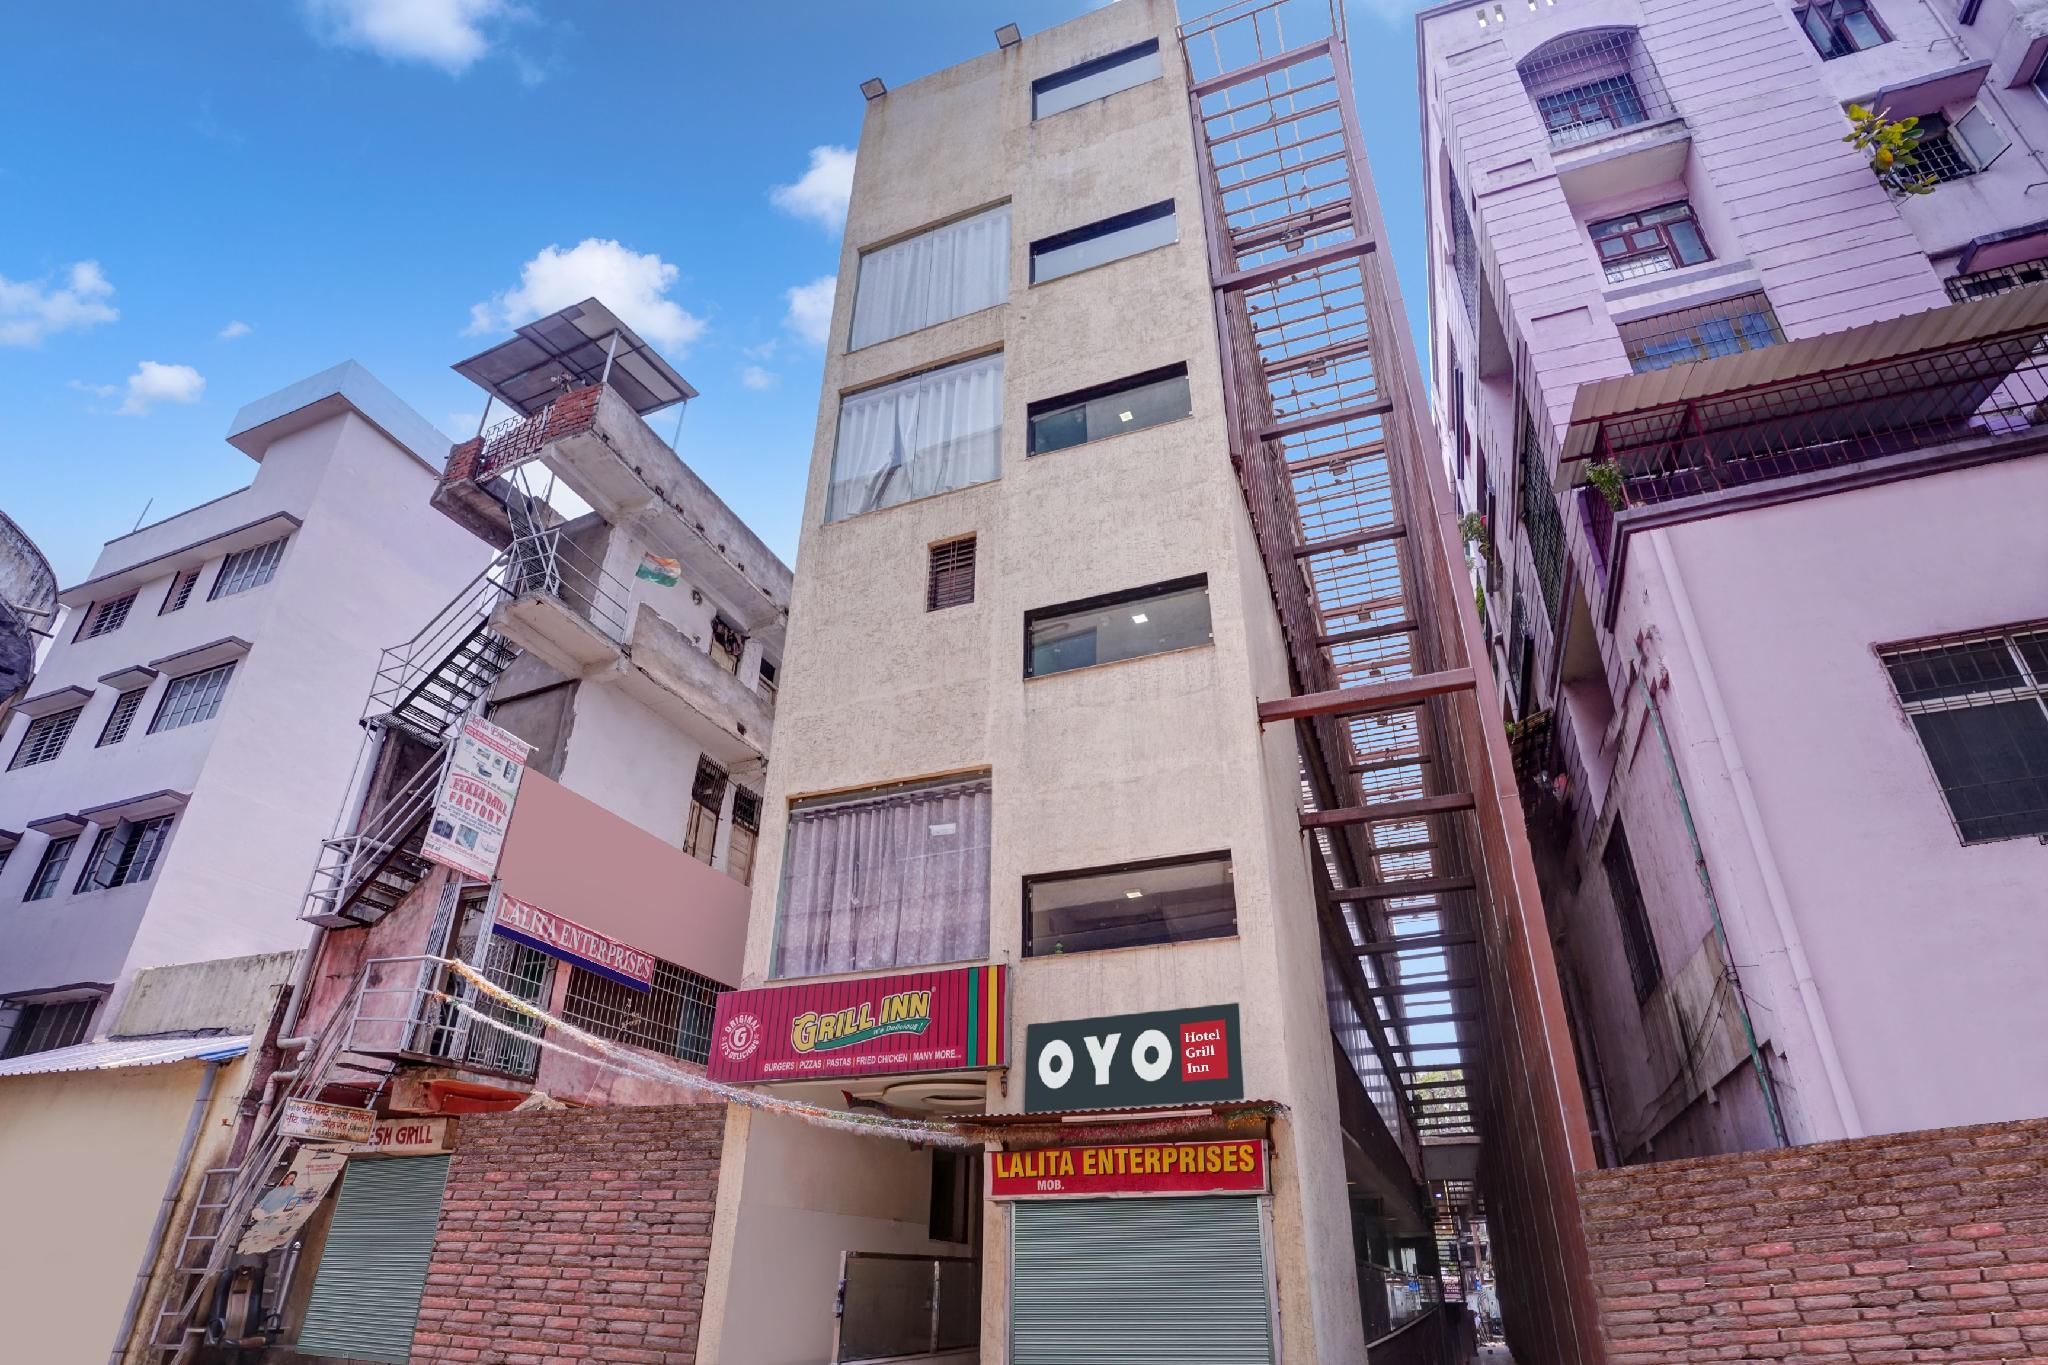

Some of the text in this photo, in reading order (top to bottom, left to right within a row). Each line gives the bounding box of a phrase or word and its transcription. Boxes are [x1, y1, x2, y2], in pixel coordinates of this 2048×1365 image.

[448, 791, 503, 825] FACTORY
[498, 898, 652, 979] LALITA ENTERPRISES
[725, 1015, 760, 1033] ORIGINAL
[792, 992, 930, 1052] GRILL INN
[734, 1027, 747, 1047] G
[1184, 1029, 1220, 1043] Hotel
[729, 1040, 760, 1060] DELICIOUS
[1038, 1029, 1172, 1089] OYO
[1185, 1044, 1215, 1059] Grill
[763, 1062, 795, 1072] BURGERS
[799, 1059, 821, 1069] PIZZAS
[826, 1057, 851, 1067] PASTAS
[856, 1055, 876, 1065] FRIED
[877, 1053, 908, 1063] CHICKEN
[912, 1051, 933, 1061] MANY
[1187, 1062, 1209, 1074] Inn
[396, 1125, 433, 1145] GRILL
[996, 1144, 1255, 1178] LALITA ENTERPRISES
[1037, 1179, 1065, 1191] MOB.
